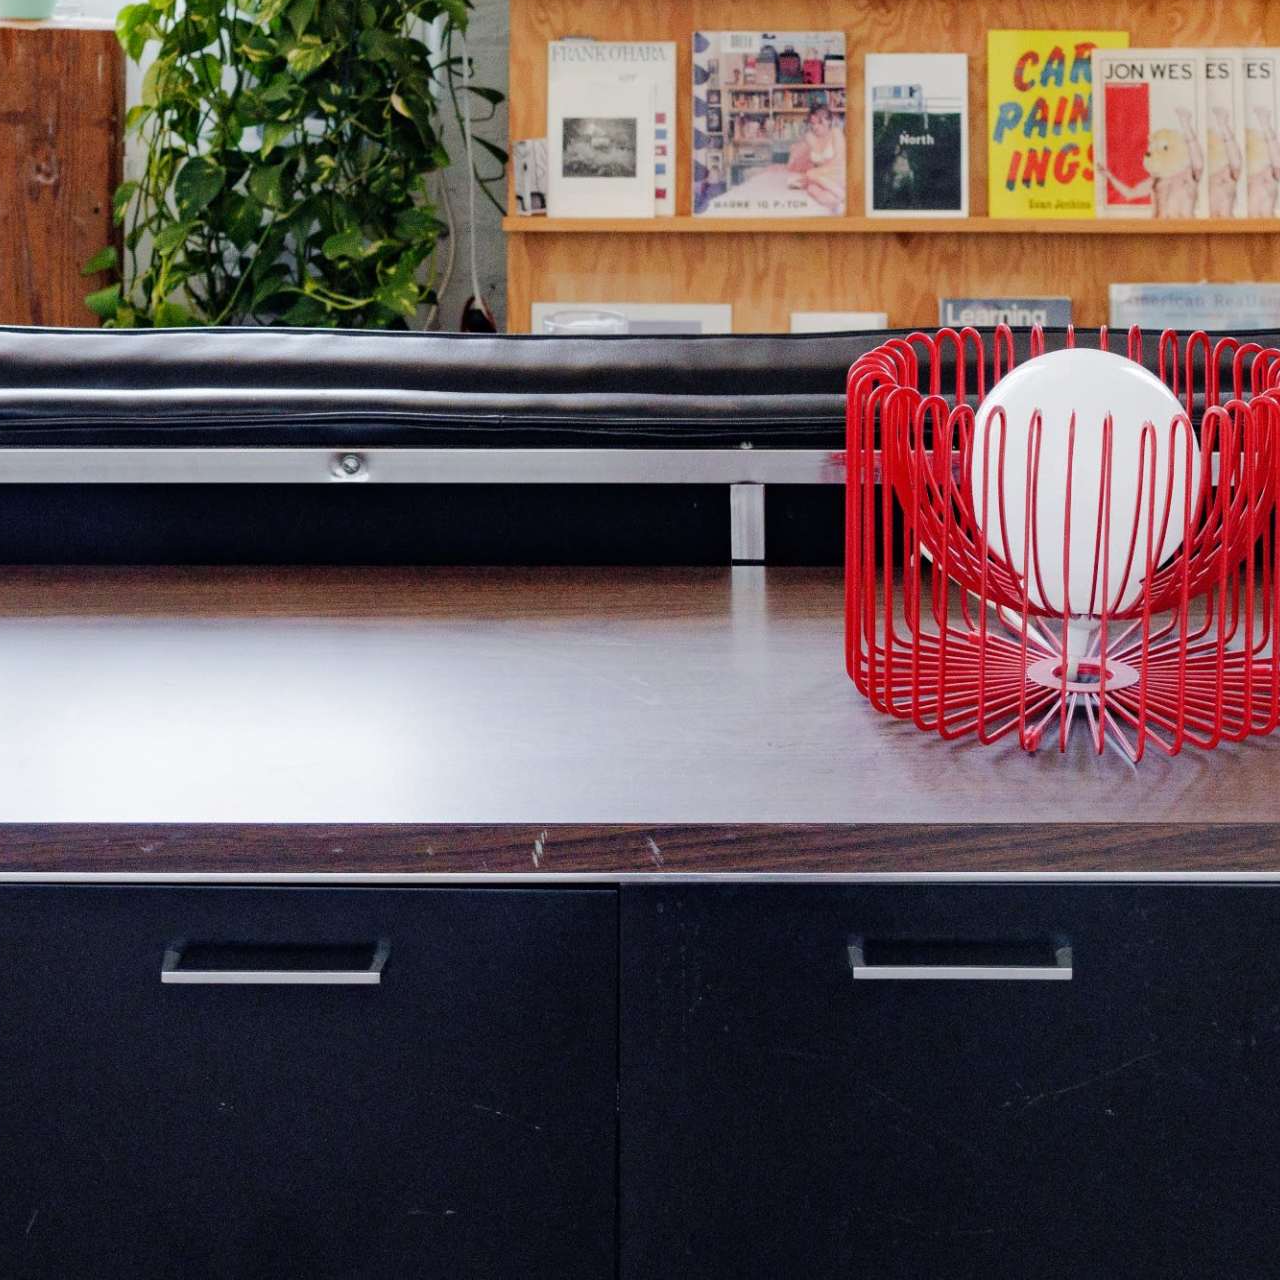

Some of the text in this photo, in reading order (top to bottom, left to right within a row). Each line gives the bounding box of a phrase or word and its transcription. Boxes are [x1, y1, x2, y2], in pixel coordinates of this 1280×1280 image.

[550, 45, 606, 62] FRANK
[1014, 41, 1097, 92] CAR
[1104, 63, 1193, 81] JON WES
[1205, 62, 1230, 80] ES
[1242, 62, 1271, 80] ES
[899, 132, 935, 146] North
[946, 303, 1048, 327] Learning
